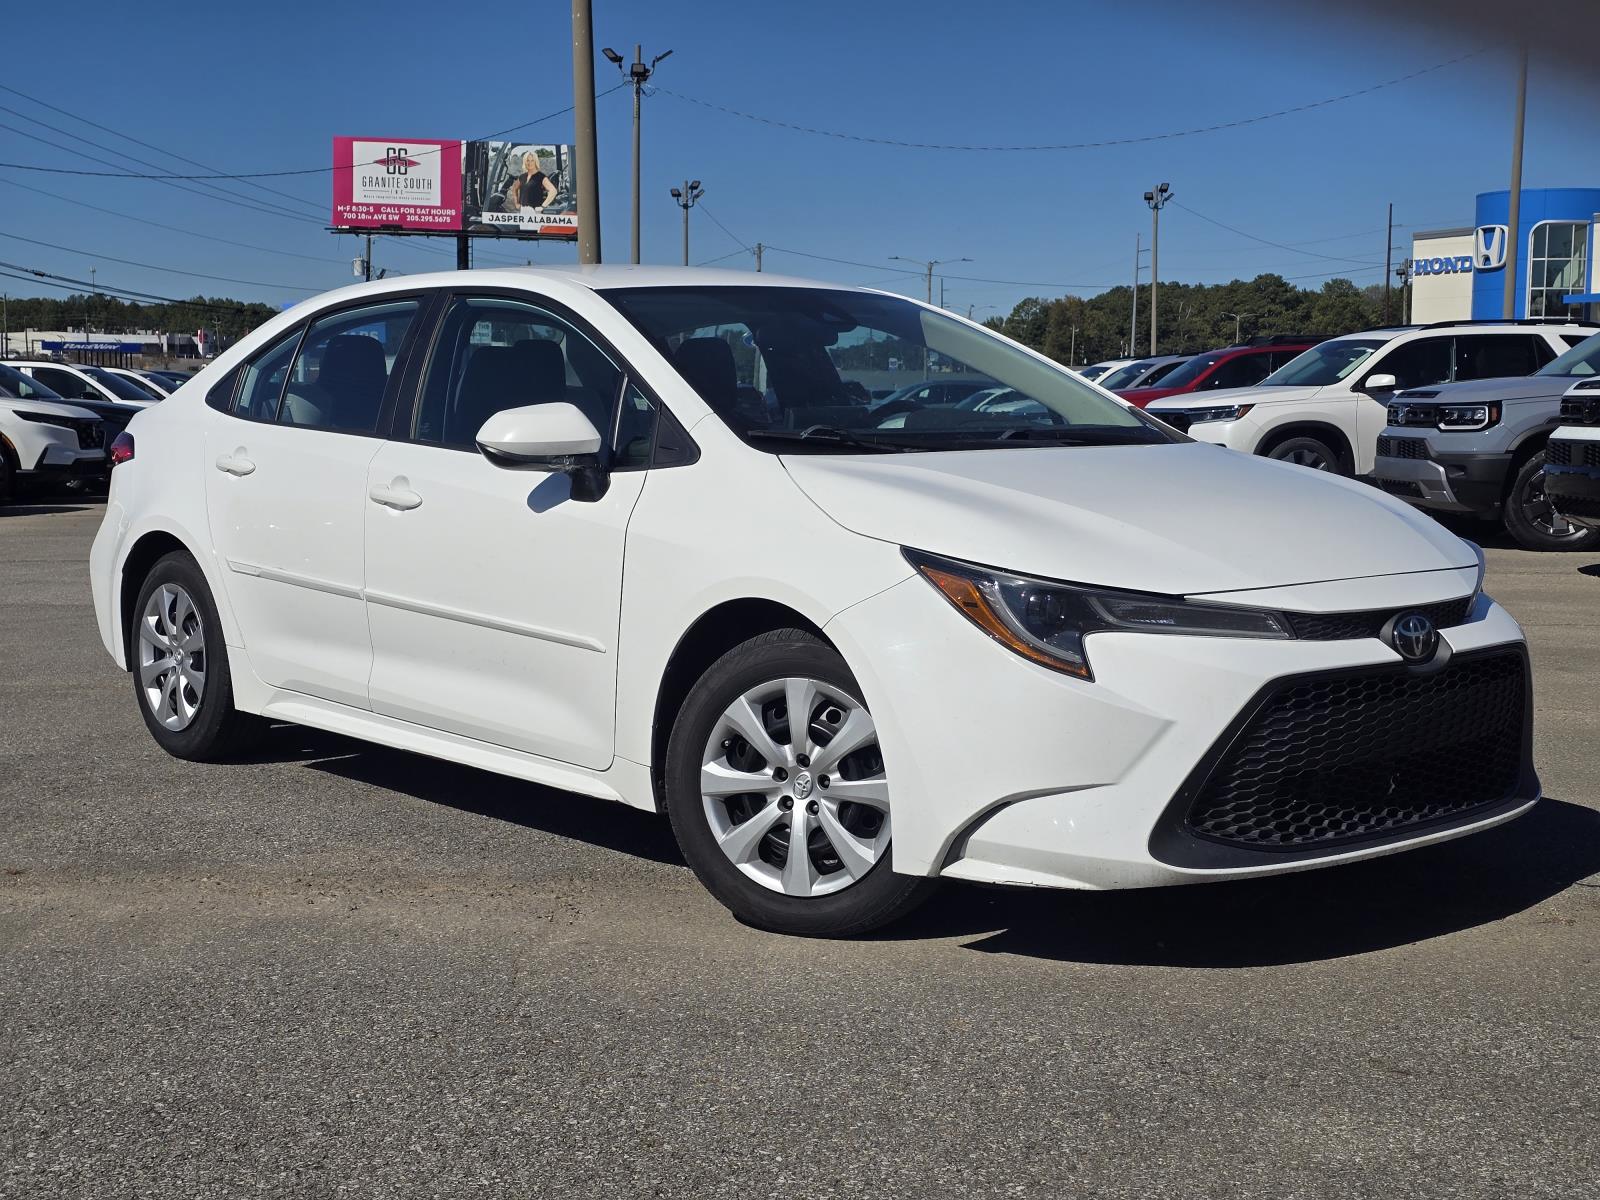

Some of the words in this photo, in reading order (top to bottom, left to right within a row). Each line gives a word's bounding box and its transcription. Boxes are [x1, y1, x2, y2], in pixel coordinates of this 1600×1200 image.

[362, 175, 401, 189] GRANITE
[403, 177, 432, 190] SOUTH
[380, 206, 400, 214] CALL
[430, 208, 456, 216] HOURS
[488, 214, 525, 223] JASPER
[527, 215, 573, 225] ALABAMA
